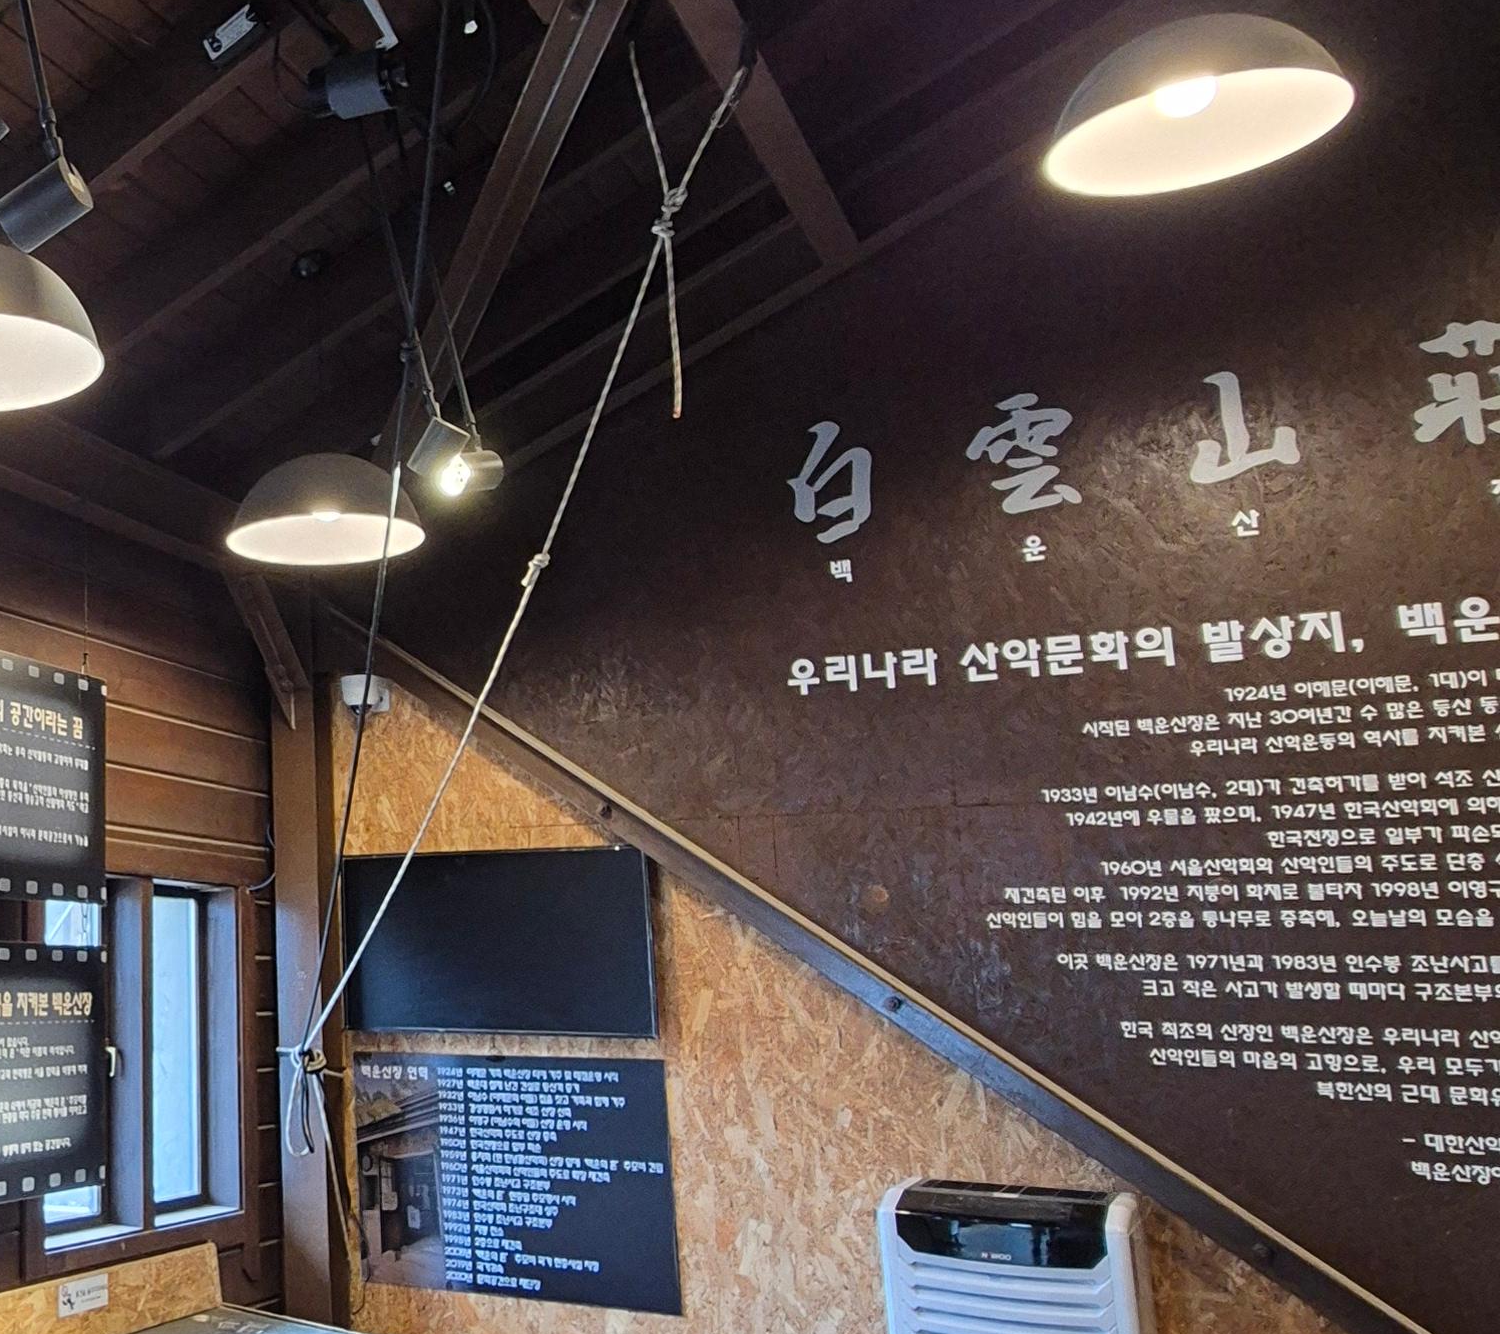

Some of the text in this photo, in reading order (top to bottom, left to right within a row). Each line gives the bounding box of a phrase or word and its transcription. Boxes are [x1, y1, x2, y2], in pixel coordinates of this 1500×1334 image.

[786, 421, 872, 543] 白
[967, 393, 1083, 514] 雲
[1189, 371, 1301, 484] 山
[829, 508, 1261, 583] 백 운 산
[787, 647, 938, 696] 우리나라
[960, 626, 1177, 684] 산악문화의
[1202, 610, 1365, 666] 발상지,
[1224, 670, 1487, 702] 1924년 1대)이
[10, 702, 67, 736] 공간이라는
[73, 716, 83, 740] 꿈
[1082, 698, 1471, 738] 시작된 백운산장은 지난 30여년간 수 많은 등산
[1190, 724, 1485, 757] 우리나라 산악운동의 역사를 지켜본
[1041, 770, 1473, 804] 1933년 2대)가 건축허가를 받아 석조
[1065, 798, 1459, 827] 1942년에 우물을 1947년 한국산악회에
[1266, 826, 1442, 848] 한국전쟁으로 일부가
[1100, 852, 1485, 877] 1960년 서울산악회와 산악인들의 주도로 단층
[1005, 881, 1439, 904] 재건축된 이후 1992년 지붕이 화재로 불타자 1998년
[986, 912, 1064, 929] 산악인들이
[1071, 911, 1102, 928] 힘을
[1110, 911, 1143, 928] 모아
[1149, 911, 1194, 928] 2층을
[1203, 910, 1271, 928] 통나무로
[1352, 909, 1426, 927] 오늘날의
[1436, 908, 1494, 927] 모습을
[1057, 953, 1401, 974] 이곳 백운산장은 1971년과 1983년 인수봉
[1142, 979, 1405, 1001] 크고 작은 사고가 발생할 때마다
[17, 992, 48, 1016] 지켜본
[52, 992, 92, 1016] 백운산장
[1120, 1021, 1460, 1048] 한국 최초의 산장인 백운산장은 우리나라
[1150, 1048, 1436, 1075] 산악인들의 마음의 우리
[1317, 1081, 1440, 1104] 북한산의 근대
